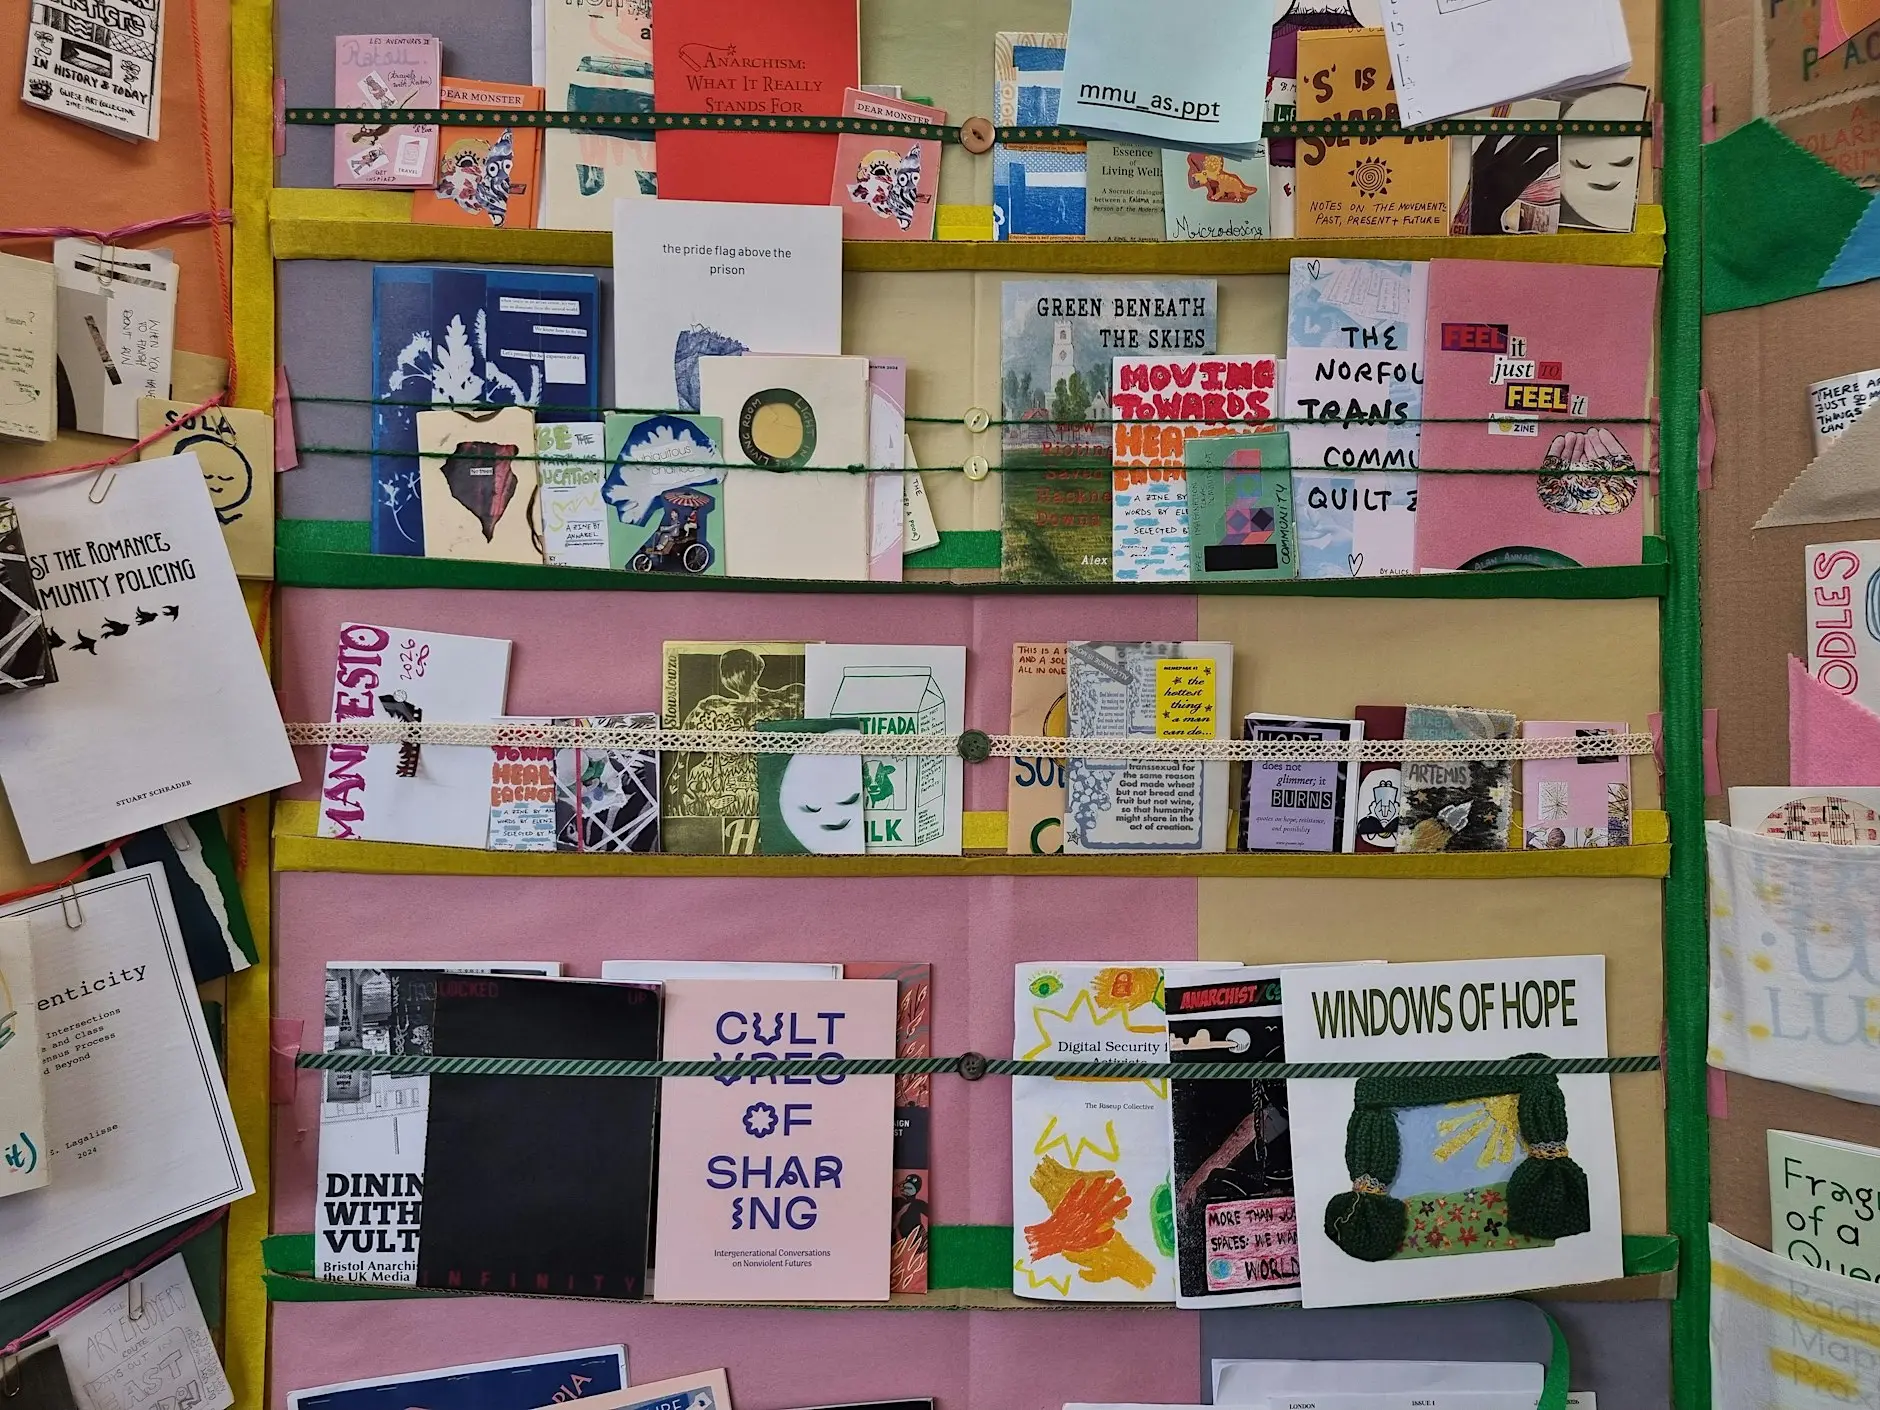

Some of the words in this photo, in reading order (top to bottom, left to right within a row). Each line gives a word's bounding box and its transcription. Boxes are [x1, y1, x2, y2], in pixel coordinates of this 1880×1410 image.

[703, 52, 806, 70] ANARCHISM:
[33, 56, 48, 69] IN
[54, 64, 98, 88] HISTORY
[112, 84, 147, 104] TODAY
[686, 76, 736, 92] WHAT
[742, 76, 757, 91] IT
[764, 76, 822, 92] REALLY
[1355, 68, 1376, 91] IS
[85, 96, 97, 105] ART
[441, 89, 468, 101] DEAR
[470, 92, 521, 104] MONSTER
[1080, 83, 1220, 122] mmu_as.ppt
[706, 99, 765, 113] STANDS
[771, 98, 803, 113] FOR
[857, 103, 883, 114] DEAR
[1113, 147, 1153, 157] Essence
[1102, 166, 1133, 178] Living
[1310, 201, 1342, 212] NOTES
[1350, 204, 1364, 212] ON
[1374, 203, 1395, 212] THE
[1400, 203, 1447, 212] MOVEMENTS
[1316, 213, 1342, 226] PAST,
[663, 244, 681, 254] the
[684, 245, 712, 256] pride
[715, 246, 735, 258] flag
[738, 248, 771, 258] above
[774, 248, 791, 258] the
[710, 265, 745, 275] prison
[1038, 298, 1100, 316] GREEN
[1114, 298, 1205, 316] BENEATH
[1100, 329, 1138, 347] THE
[1149, 329, 1205, 348] SKIES
[1341, 326, 1398, 350] THE
[1443, 327, 1506, 348] FEEL
[1512, 338, 1525, 356] it
[1120, 360, 1274, 392] MOVING
[1490, 357, 1533, 384] just
[1540, 365, 1559, 376] TO
[1508, 386, 1566, 409] FEEL
[1572, 396, 1584, 414] it
[1812, 383, 1859, 401] THERE
[1113, 391, 1270, 427] TOWARDS
[1821, 423, 1843, 433] CAN
[1308, 487, 1391, 510] QUILT
[1036, 511, 1100, 526] Downs
[1134, 527, 1177, 535] SELECTED
[53, 548, 82, 571] THE
[86, 533, 171, 565] ROMANCE
[1082, 555, 1108, 564] Alex
[115, 559, 197, 594] POLICING
[1018, 646, 1037, 654] THIS
[1020, 656, 1036, 664] AND
[1018, 666, 1032, 674] ALL
[1049, 667, 1066, 675] ONE
[1188, 677, 1204, 685] the
[1164, 688, 1202, 696] hottest
[1170, 700, 1201, 714] thing
[1262, 761, 1282, 770] does
[1286, 762, 1301, 771] not
[1409, 764, 1467, 784] ARTEMIS
[1120, 780, 1137, 788] God
[1277, 774, 1316, 786] glimmer;
[1319, 777, 1326, 785] it
[116, 792, 147, 807] STUART
[149, 780, 192, 798] SCHRADER
[1272, 790, 1332, 808] BURNS
[1171, 798, 1193, 806] wine,
[1116, 815, 1140, 823] might
[1153, 806, 1194, 816] humanity
[1156, 823, 1193, 831] creation.
[37, 965, 147, 1012] enticity
[1180, 985, 1257, 1010] ANARCHIST
[1311, 985, 1453, 1039] WINDOWS
[1460, 983, 1495, 1031] OF
[1502, 980, 1577, 1028] HOPE
[46, 1008, 121, 1039] Intersections
[716, 1011, 845, 1046] CULT
[53, 1039, 70, 1050] and
[75, 1026, 104, 1041] Class
[75, 1033, 116, 1050] Process
[1058, 1041, 1101, 1054] Digital
[1105, 1041, 1160, 1054] Security
[55, 1053, 91, 1071] Beyond
[743, 1102, 812, 1138] OF
[66, 1124, 118, 1150] Lagalisse
[77, 1147, 97, 1159] 2024
[707, 1155, 842, 1189] SHAR
[325, 1201, 420, 1226] WITH
[732, 1196, 817, 1230] ING
[1208, 1209, 1240, 1225] MORE
[1246, 1209, 1273, 1223] THAN
[1787, 1206, 1825, 1236] of
[1838, 1225, 1859, 1246] a
[323, 1229, 419, 1253] VULT
[1211, 1235, 1249, 1250] SPACES:
[1254, 1233, 1273, 1248] WE
[714, 1249, 777, 1258] Intergenerational
[779, 1249, 830, 1257] Conversations
[324, 1261, 363, 1271] Bristol
[744, 1259, 783, 1267] Nonviolent
[785, 1259, 812, 1267] Futures
[323, 1273, 344, 1282] the
[349, 1271, 367, 1281] UK
[371, 1271, 410, 1282] Media
